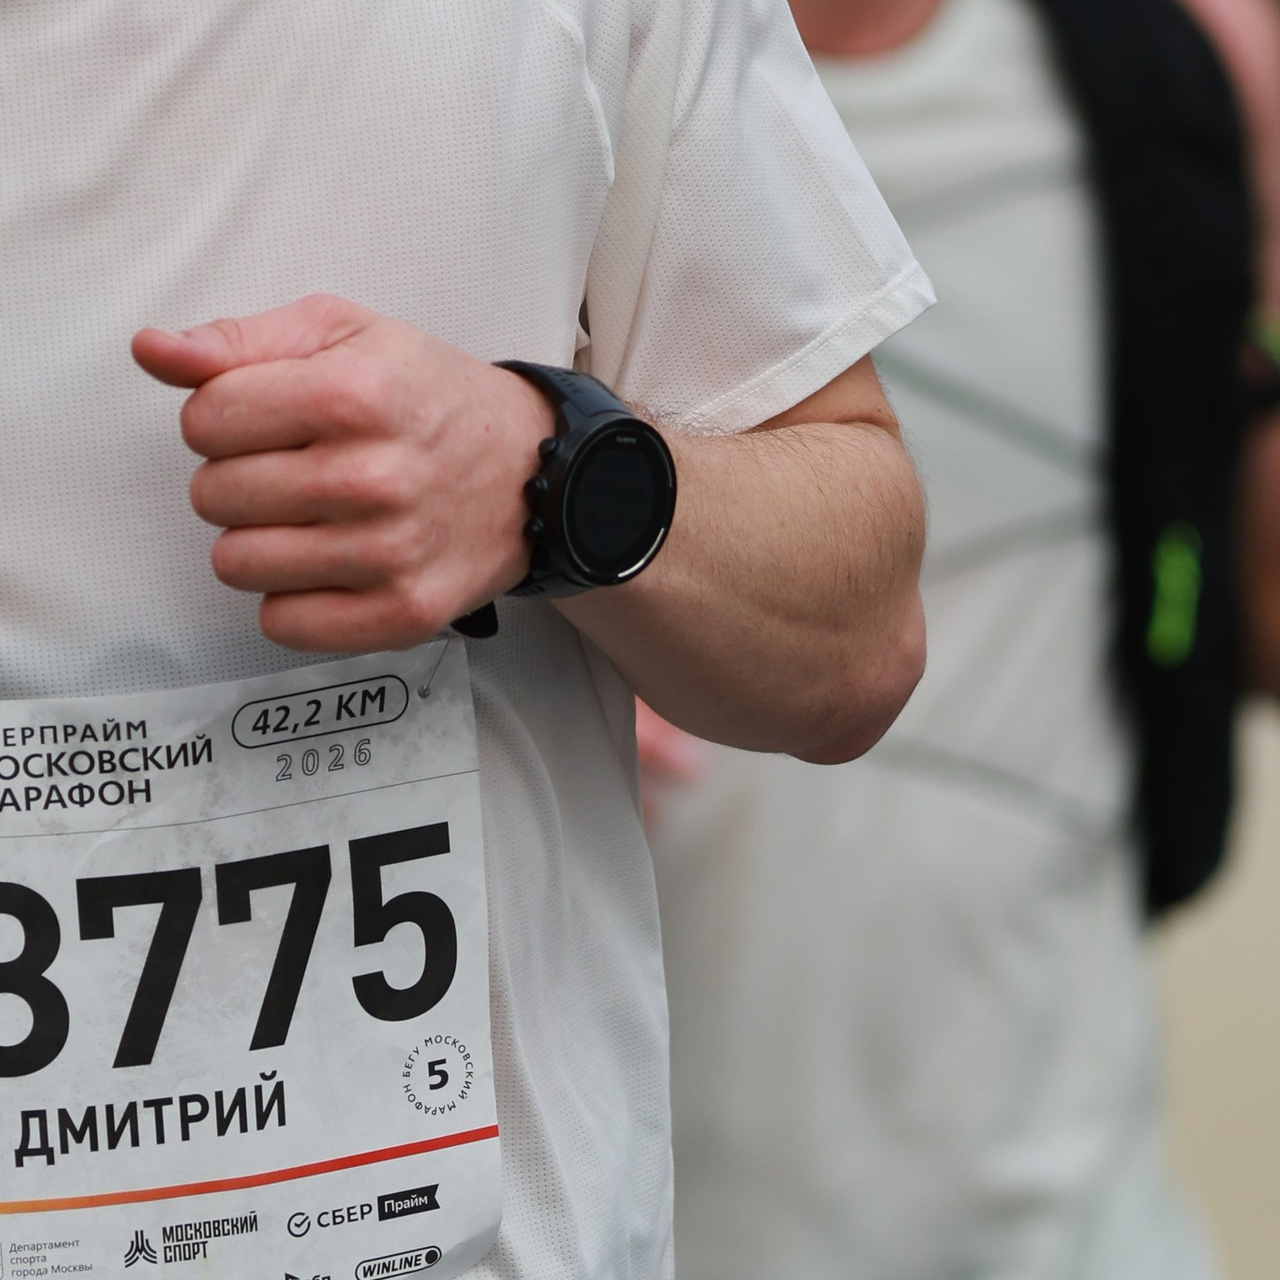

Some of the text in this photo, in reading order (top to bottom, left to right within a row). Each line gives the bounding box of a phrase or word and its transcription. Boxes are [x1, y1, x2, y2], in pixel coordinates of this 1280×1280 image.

[251, 685, 387, 737] 42,2 КМ
[275, 738, 373, 782] 2026
[402, 1034, 475, 1116] БЕГУ МОСКОВСКИЙ МАРАФОН
[427, 1058, 450, 1091] 5
[14, 1070, 288, 1168] ДМИТРИЙ
[161, 1210, 259, 1245] МОСКОВСКИЙ
[316, 1194, 429, 1228] СБЕР Прайм
[8, 1239, 81, 1254] Департамент
[10, 1255, 47, 1266] спорта
[163, 1240, 209, 1264] СПОРТ
[11, 1263, 93, 1279] города Москвы
[362, 1253, 423, 1279] WINLINE
